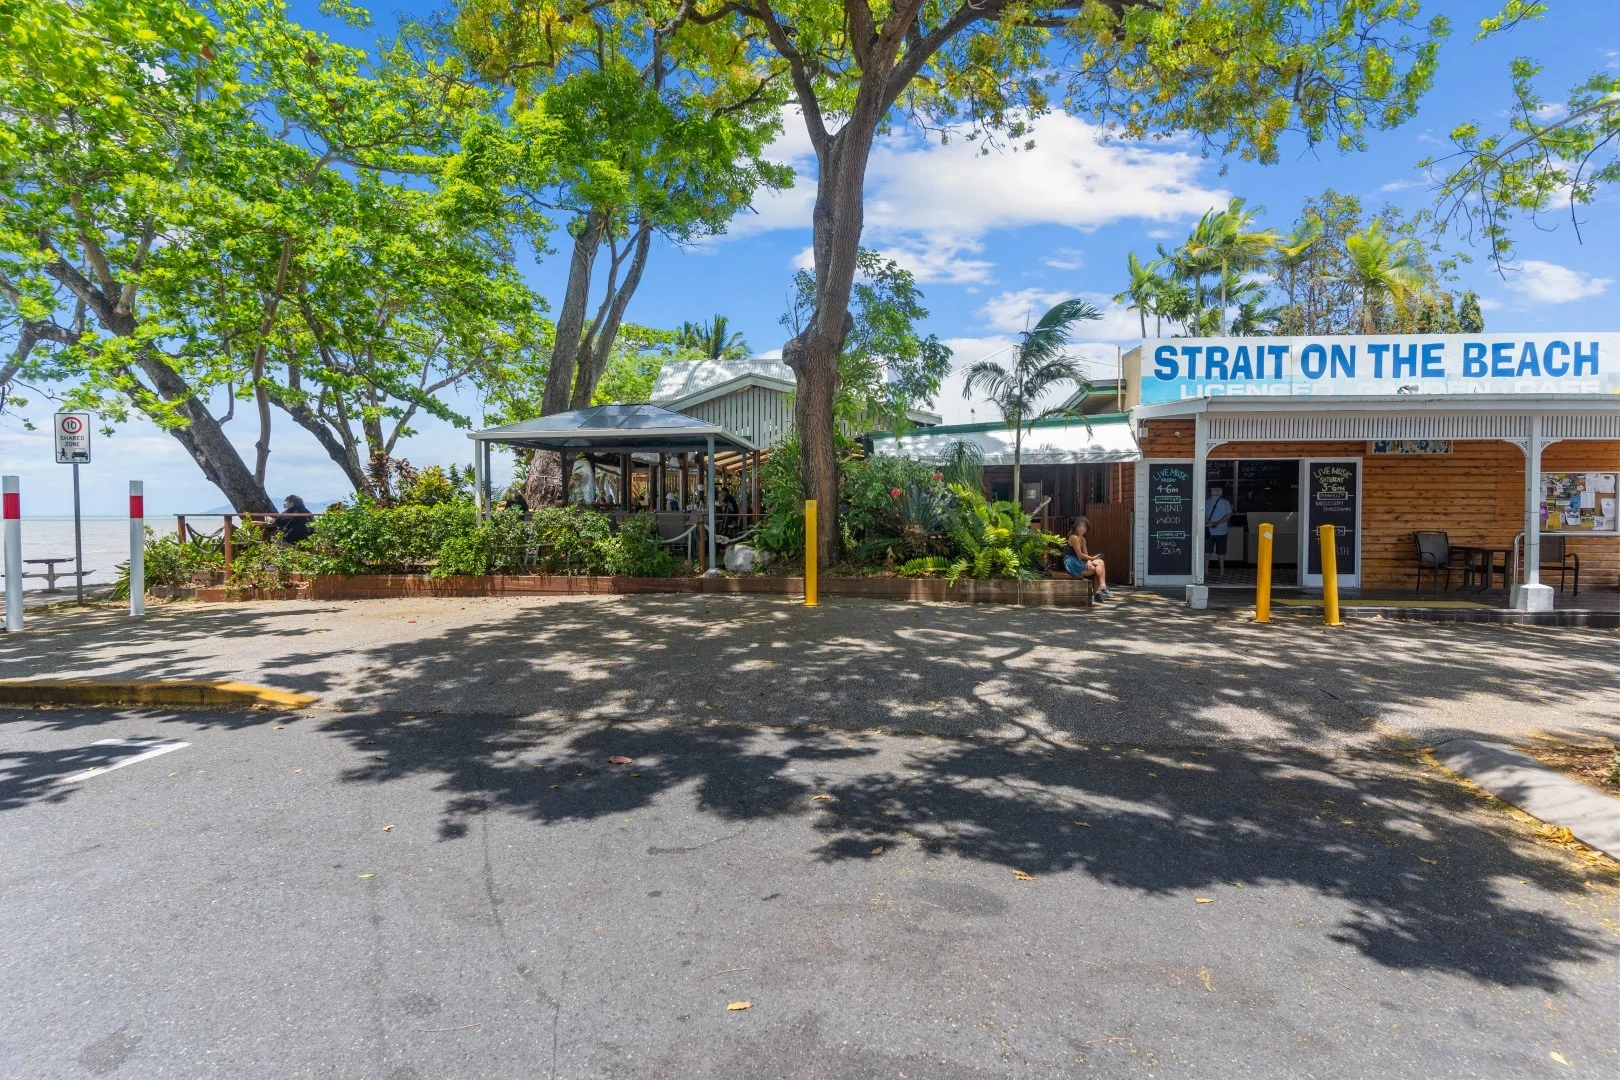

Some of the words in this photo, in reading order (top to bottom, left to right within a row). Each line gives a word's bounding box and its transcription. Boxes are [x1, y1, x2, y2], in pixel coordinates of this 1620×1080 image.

[1154, 345, 1289, 380] STRAIT
[1301, 343, 1356, 379] ON
[1368, 343, 1445, 378] THE
[1463, 340, 1599, 378] BEACH
[67, 420, 77, 429] 10
[1153, 468, 1168, 481] LIVE
[1169, 468, 1188, 480] MUSIC
[1313, 467, 1330, 478] LIVE
[1331, 467, 1352, 479] MUSIC
[1155, 504, 1182, 512] WIND
[1156, 516, 1181, 524] WOOD
